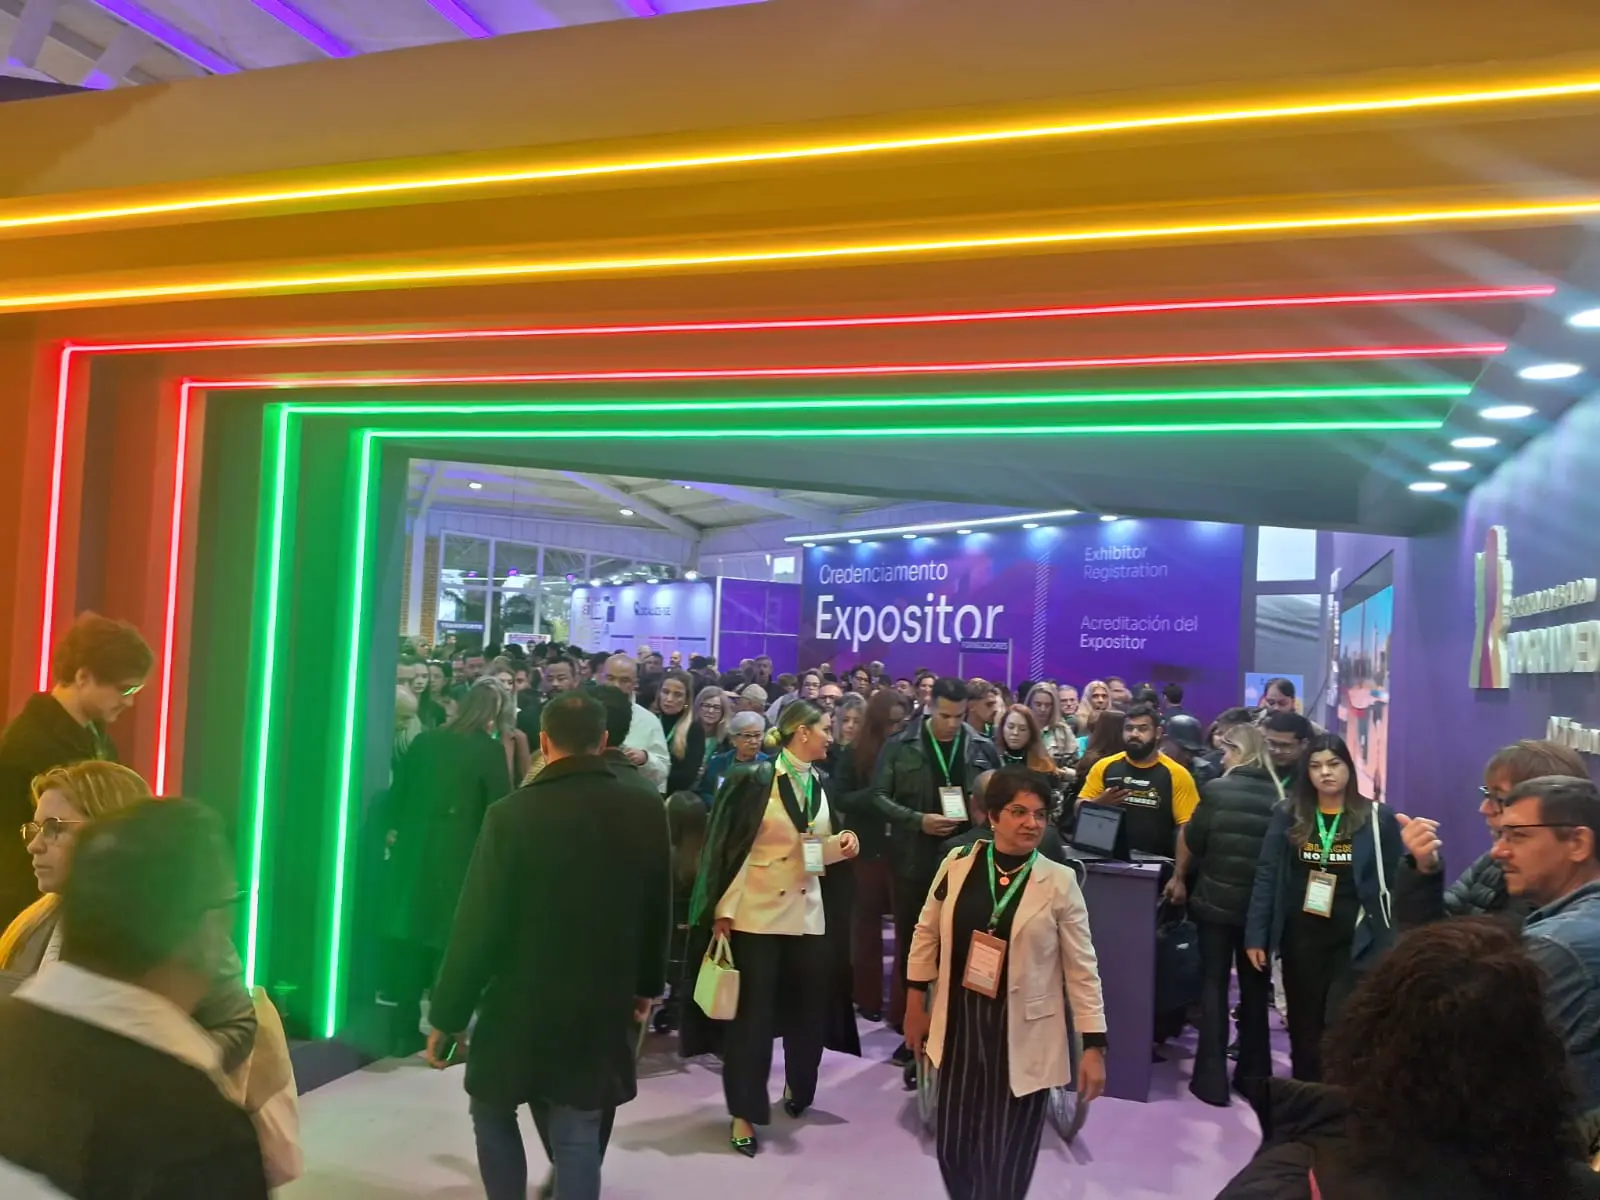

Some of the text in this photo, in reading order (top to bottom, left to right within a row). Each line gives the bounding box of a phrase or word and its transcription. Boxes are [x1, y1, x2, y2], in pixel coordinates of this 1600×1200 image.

[1084, 545, 1147, 561] Exhibitor
[819, 560, 948, 584] Credenciamento
[1083, 563, 1168, 582] Registration
[815, 592, 1004, 653] Expositor
[1080, 614, 1199, 632] Acreditación del
[1079, 633, 1147, 651] Expositor
